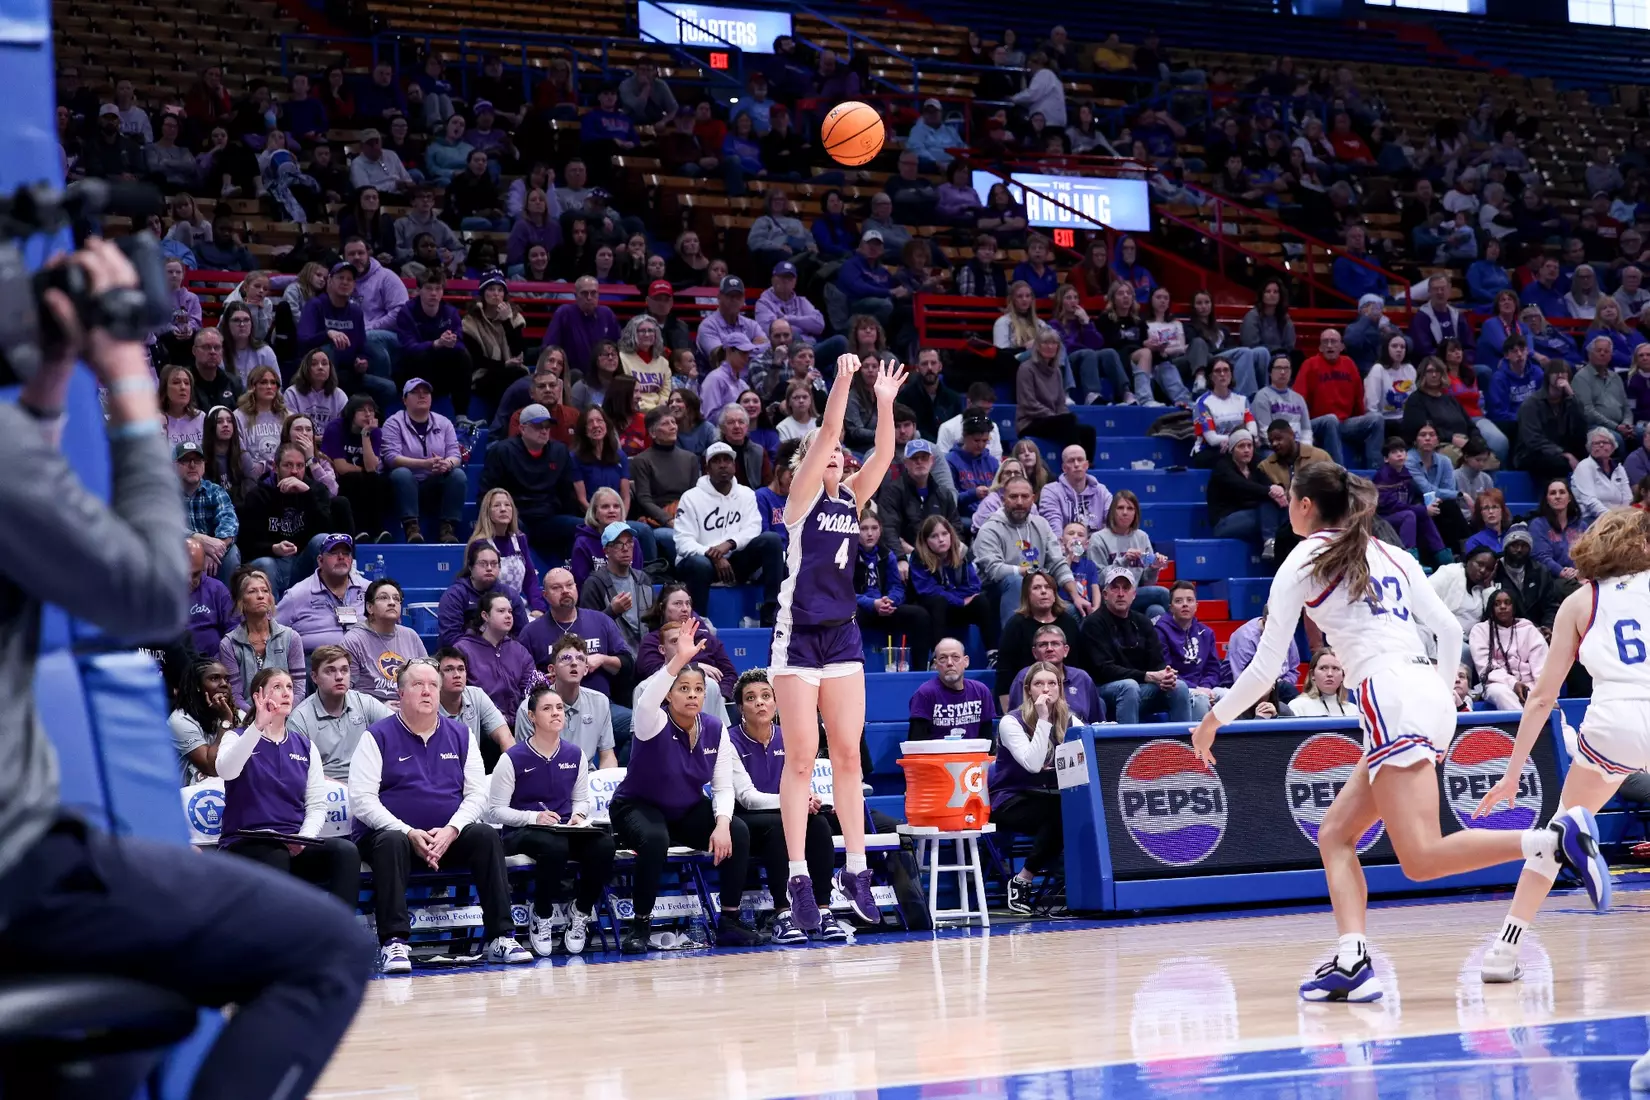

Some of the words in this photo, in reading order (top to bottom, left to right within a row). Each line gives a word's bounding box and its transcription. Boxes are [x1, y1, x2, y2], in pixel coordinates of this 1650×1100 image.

[711, 53, 728, 67] EXIT
[1053, 182, 1072, 191] THE
[1054, 229, 1074, 246] EXIT
[834, 537, 849, 569] 4
[190, 604, 211, 615] Cats
[1613, 618, 1647, 665] 6
[933, 701, 982, 717] K-STATE
[932, 716, 955, 727] WOMEN'S
[956, 713, 981, 725] BASKETBALL
[964, 766, 983, 793] G
[1124, 787, 1222, 817] PEPSI
[418, 913, 450, 925] Capitol
